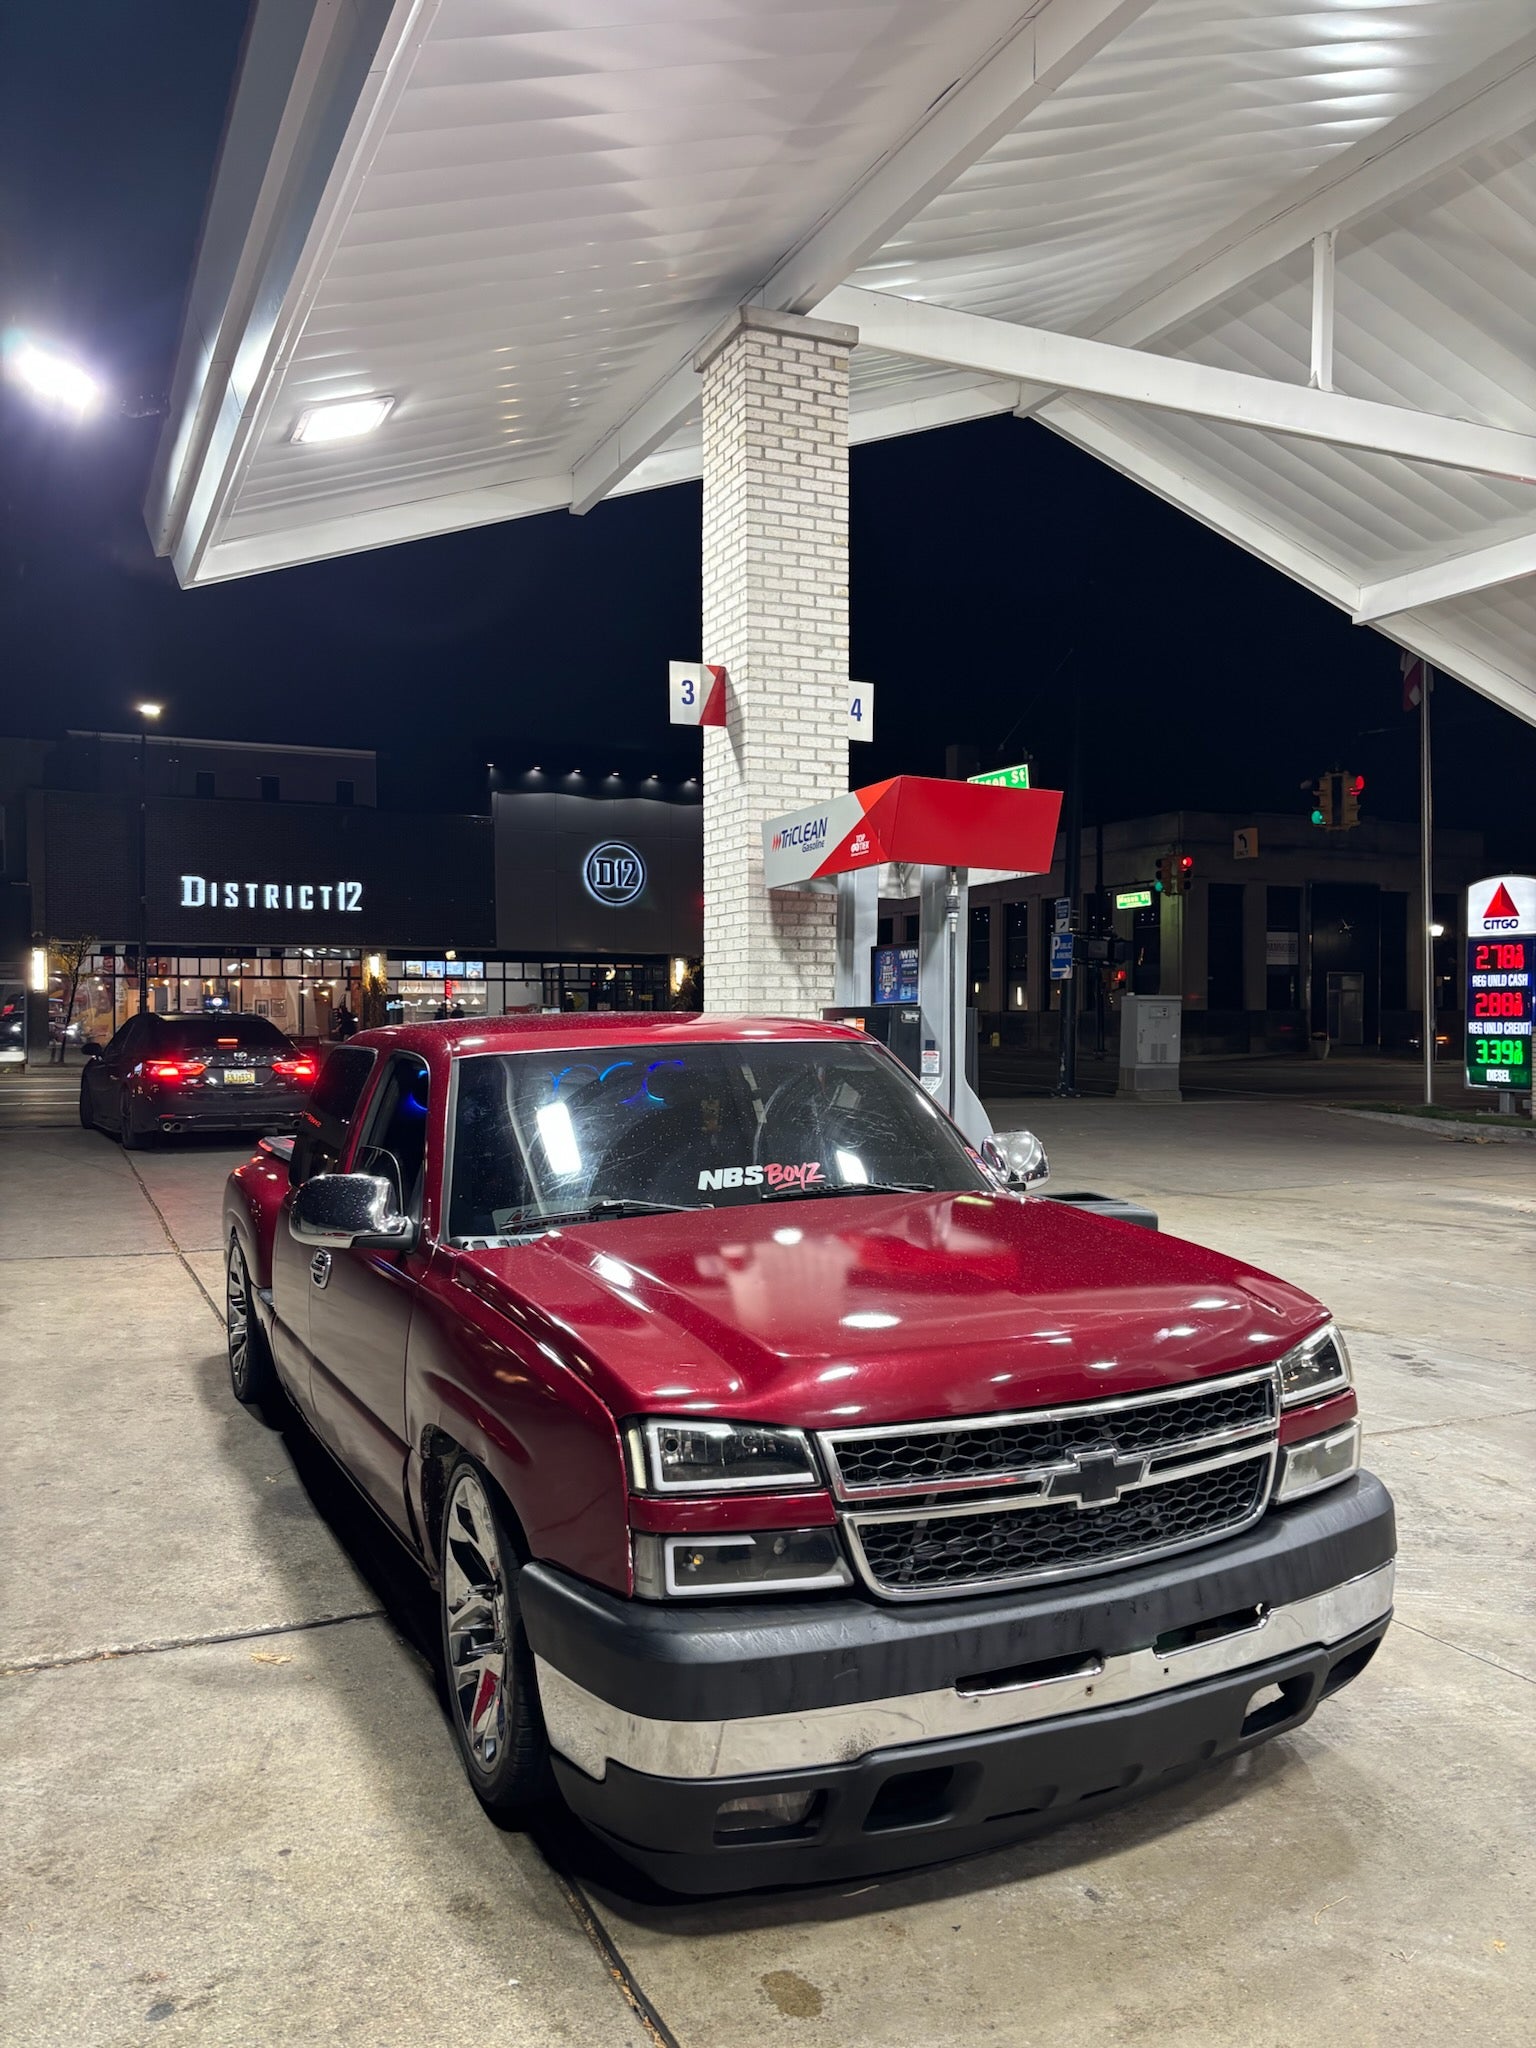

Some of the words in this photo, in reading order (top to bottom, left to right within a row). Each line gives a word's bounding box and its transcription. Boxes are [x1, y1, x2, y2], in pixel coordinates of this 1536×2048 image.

[681, 680, 695, 705] 3
[850, 698, 863, 722] 4
[1011, 769, 1026, 784] St
[781, 817, 828, 848] TriCLEAN
[802, 840, 825, 853] Gasoline
[595, 858, 637, 888] D12
[1483, 919, 1519, 930] CITGO
[900, 949, 918, 960] WIN
[1472, 974, 1487, 987] REG
[1487, 974, 1507, 987] UNLD
[1508, 973, 1528, 986] CASH
[1468, 1022, 1483, 1035] REG
[1483, 1022, 1503, 1035] UNLD
[1504, 1021, 1531, 1035] CREDIT
[1486, 1068, 1511, 1083] DIESEL
[698, 1165, 764, 1191] NBS
